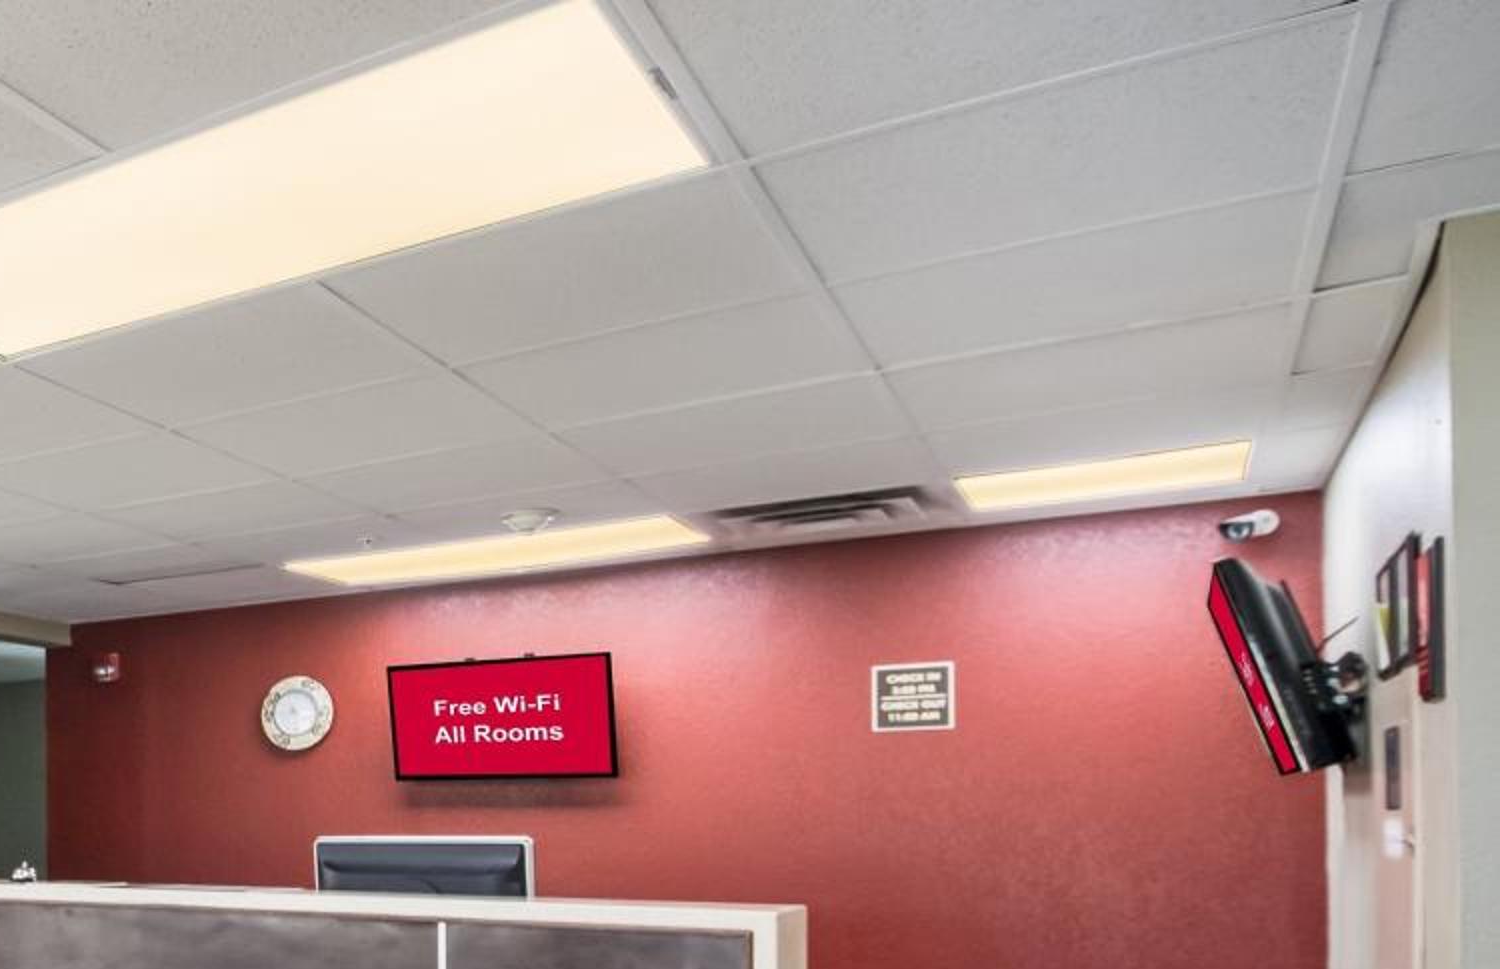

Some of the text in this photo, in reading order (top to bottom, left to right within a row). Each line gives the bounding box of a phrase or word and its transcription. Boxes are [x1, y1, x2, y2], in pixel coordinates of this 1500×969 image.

[433, 693, 562, 716] Free Wi-Fi
[434, 724, 564, 744] All Rooms
